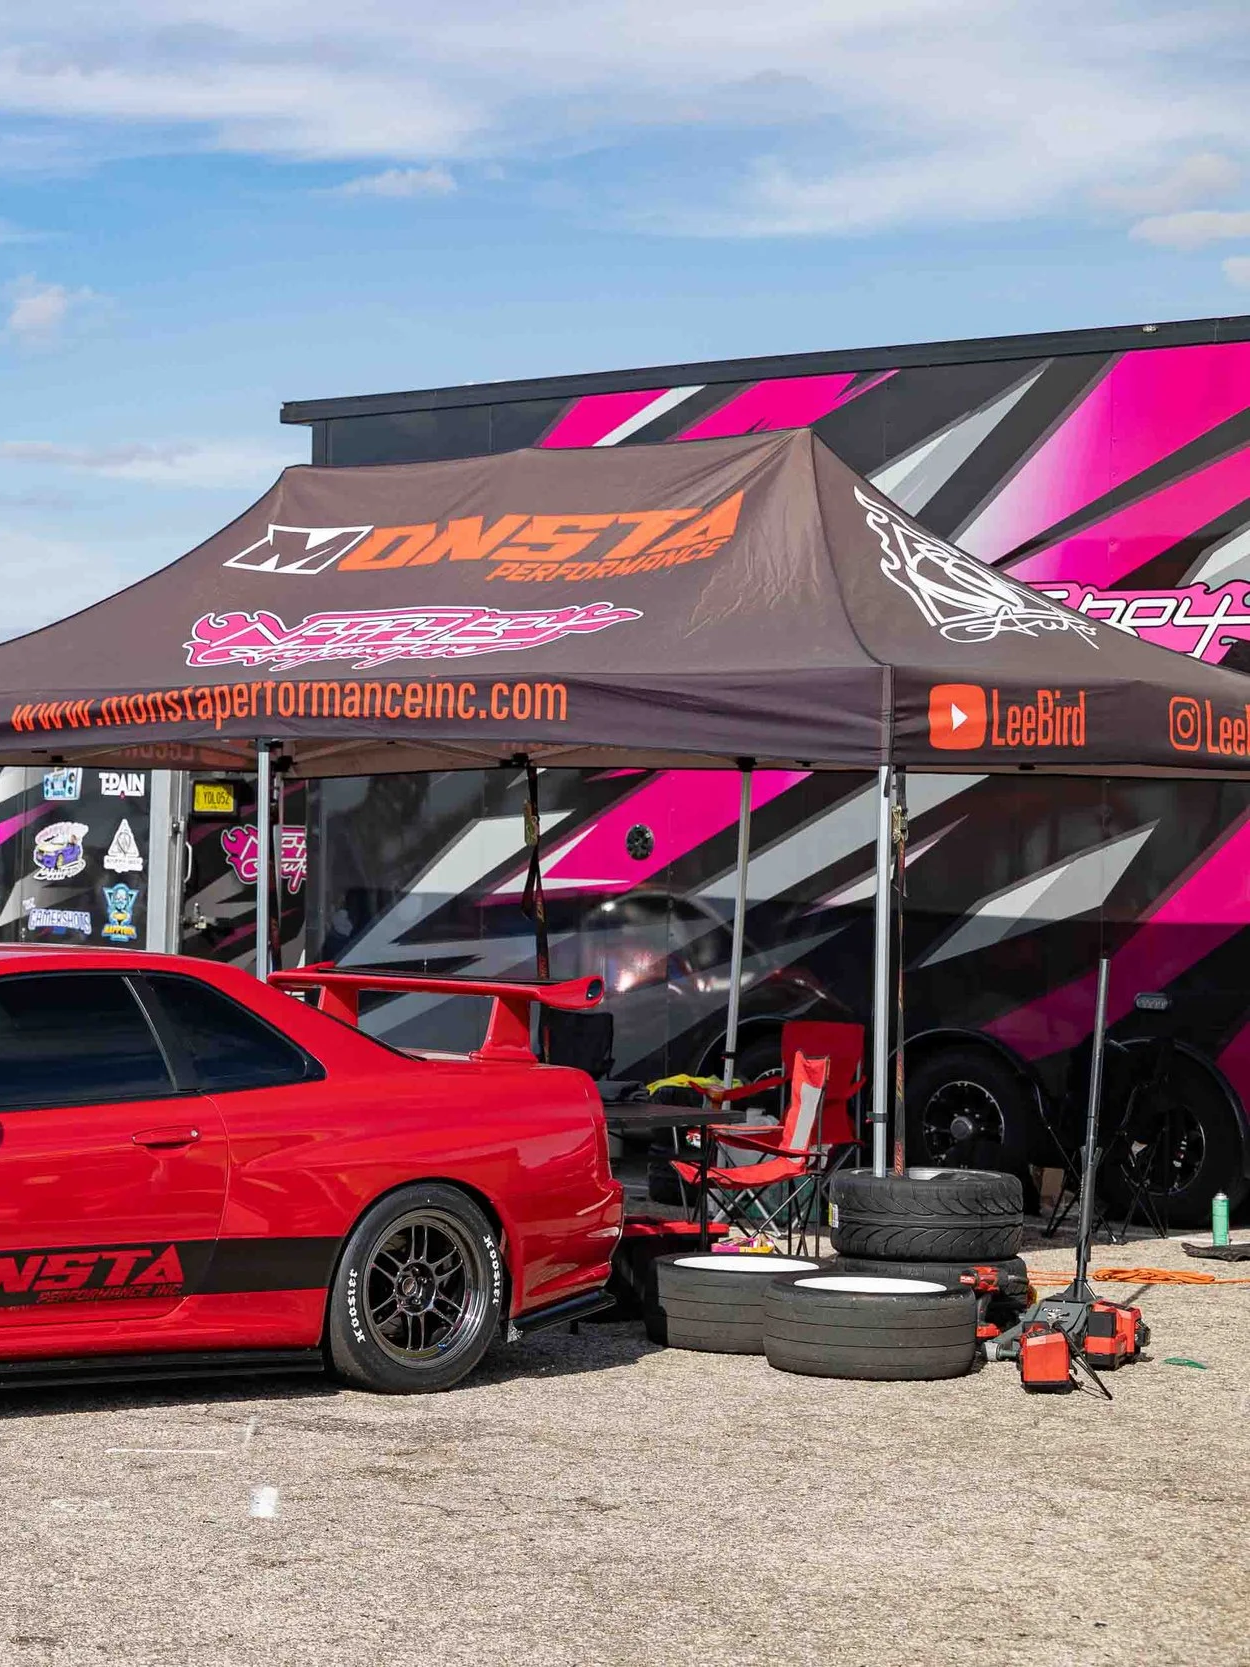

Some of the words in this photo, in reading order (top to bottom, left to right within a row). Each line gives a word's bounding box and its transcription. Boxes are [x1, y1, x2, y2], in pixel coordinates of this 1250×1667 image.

[485, 539, 731, 582] PERFORMANCE
[11, 676, 568, 731] www.monstaperformanceinc.com
[992, 689, 1087, 746] LeeBird
[38, 1286, 148, 1303] PERFORMANCE
[483, 1234, 500, 1306] Hoosier
[347, 1269, 366, 1343] Hoosier
